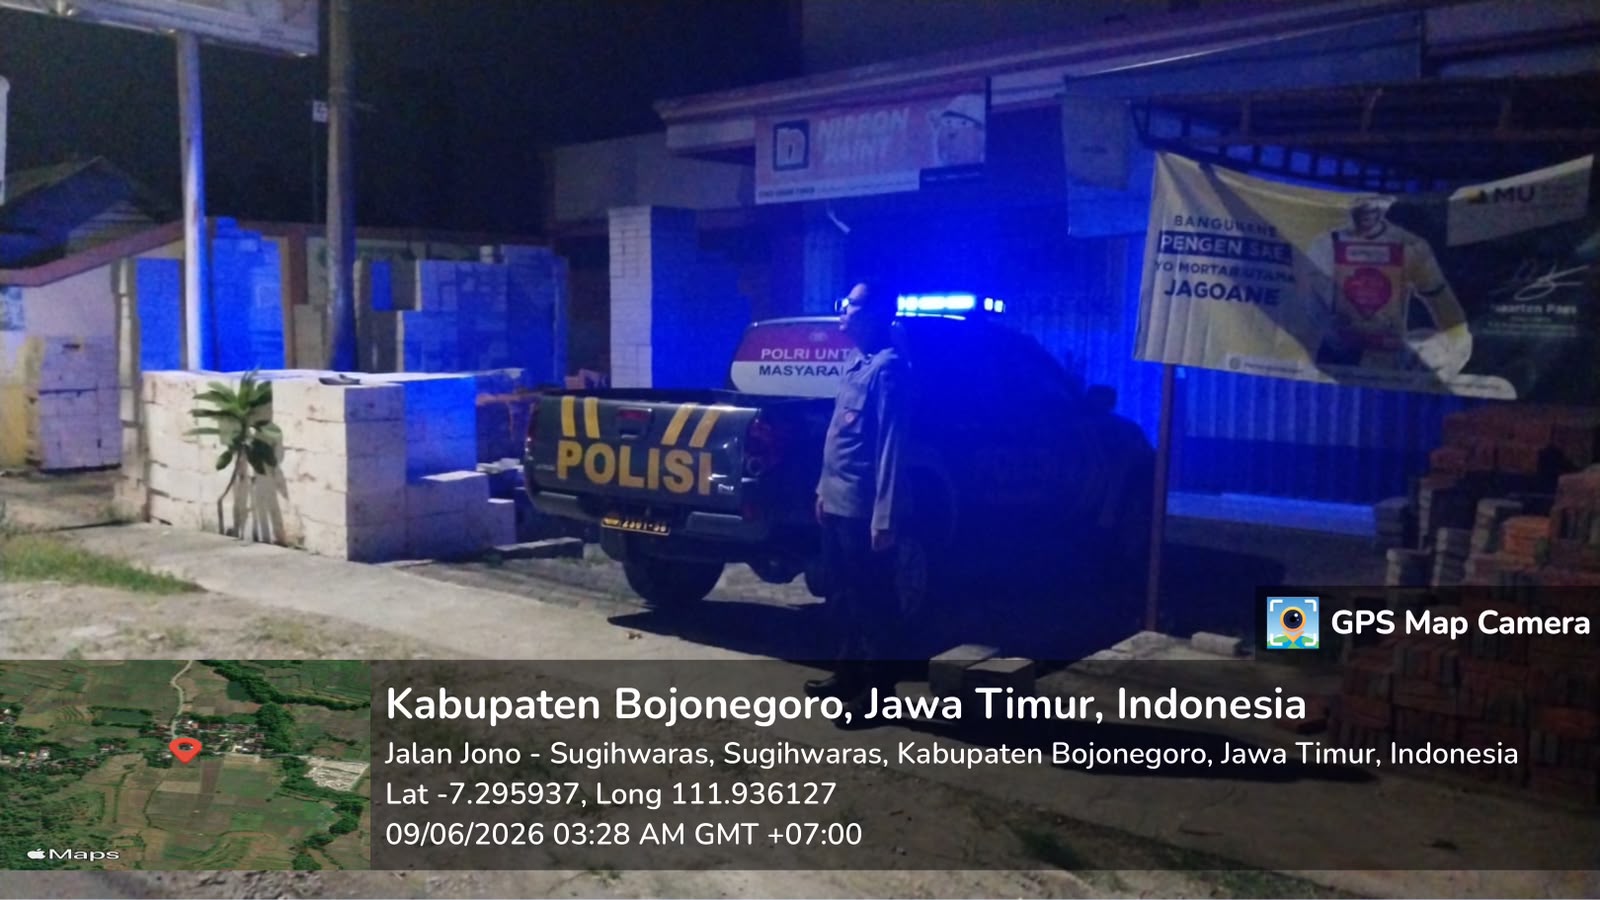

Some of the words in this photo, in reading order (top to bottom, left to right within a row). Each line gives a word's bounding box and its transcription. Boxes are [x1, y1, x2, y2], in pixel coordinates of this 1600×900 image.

[1160, 234, 1243, 256] PENGEN
[1155, 261, 1174, 273] YO
[1178, 261, 1241, 279] MORTAR
[1164, 279, 1281, 306] JAGOANE
[761, 347, 810, 361] POLRI
[815, 348, 849, 360] UNT
[759, 364, 845, 377] MASYARA
[557, 439, 712, 496] POLISI
